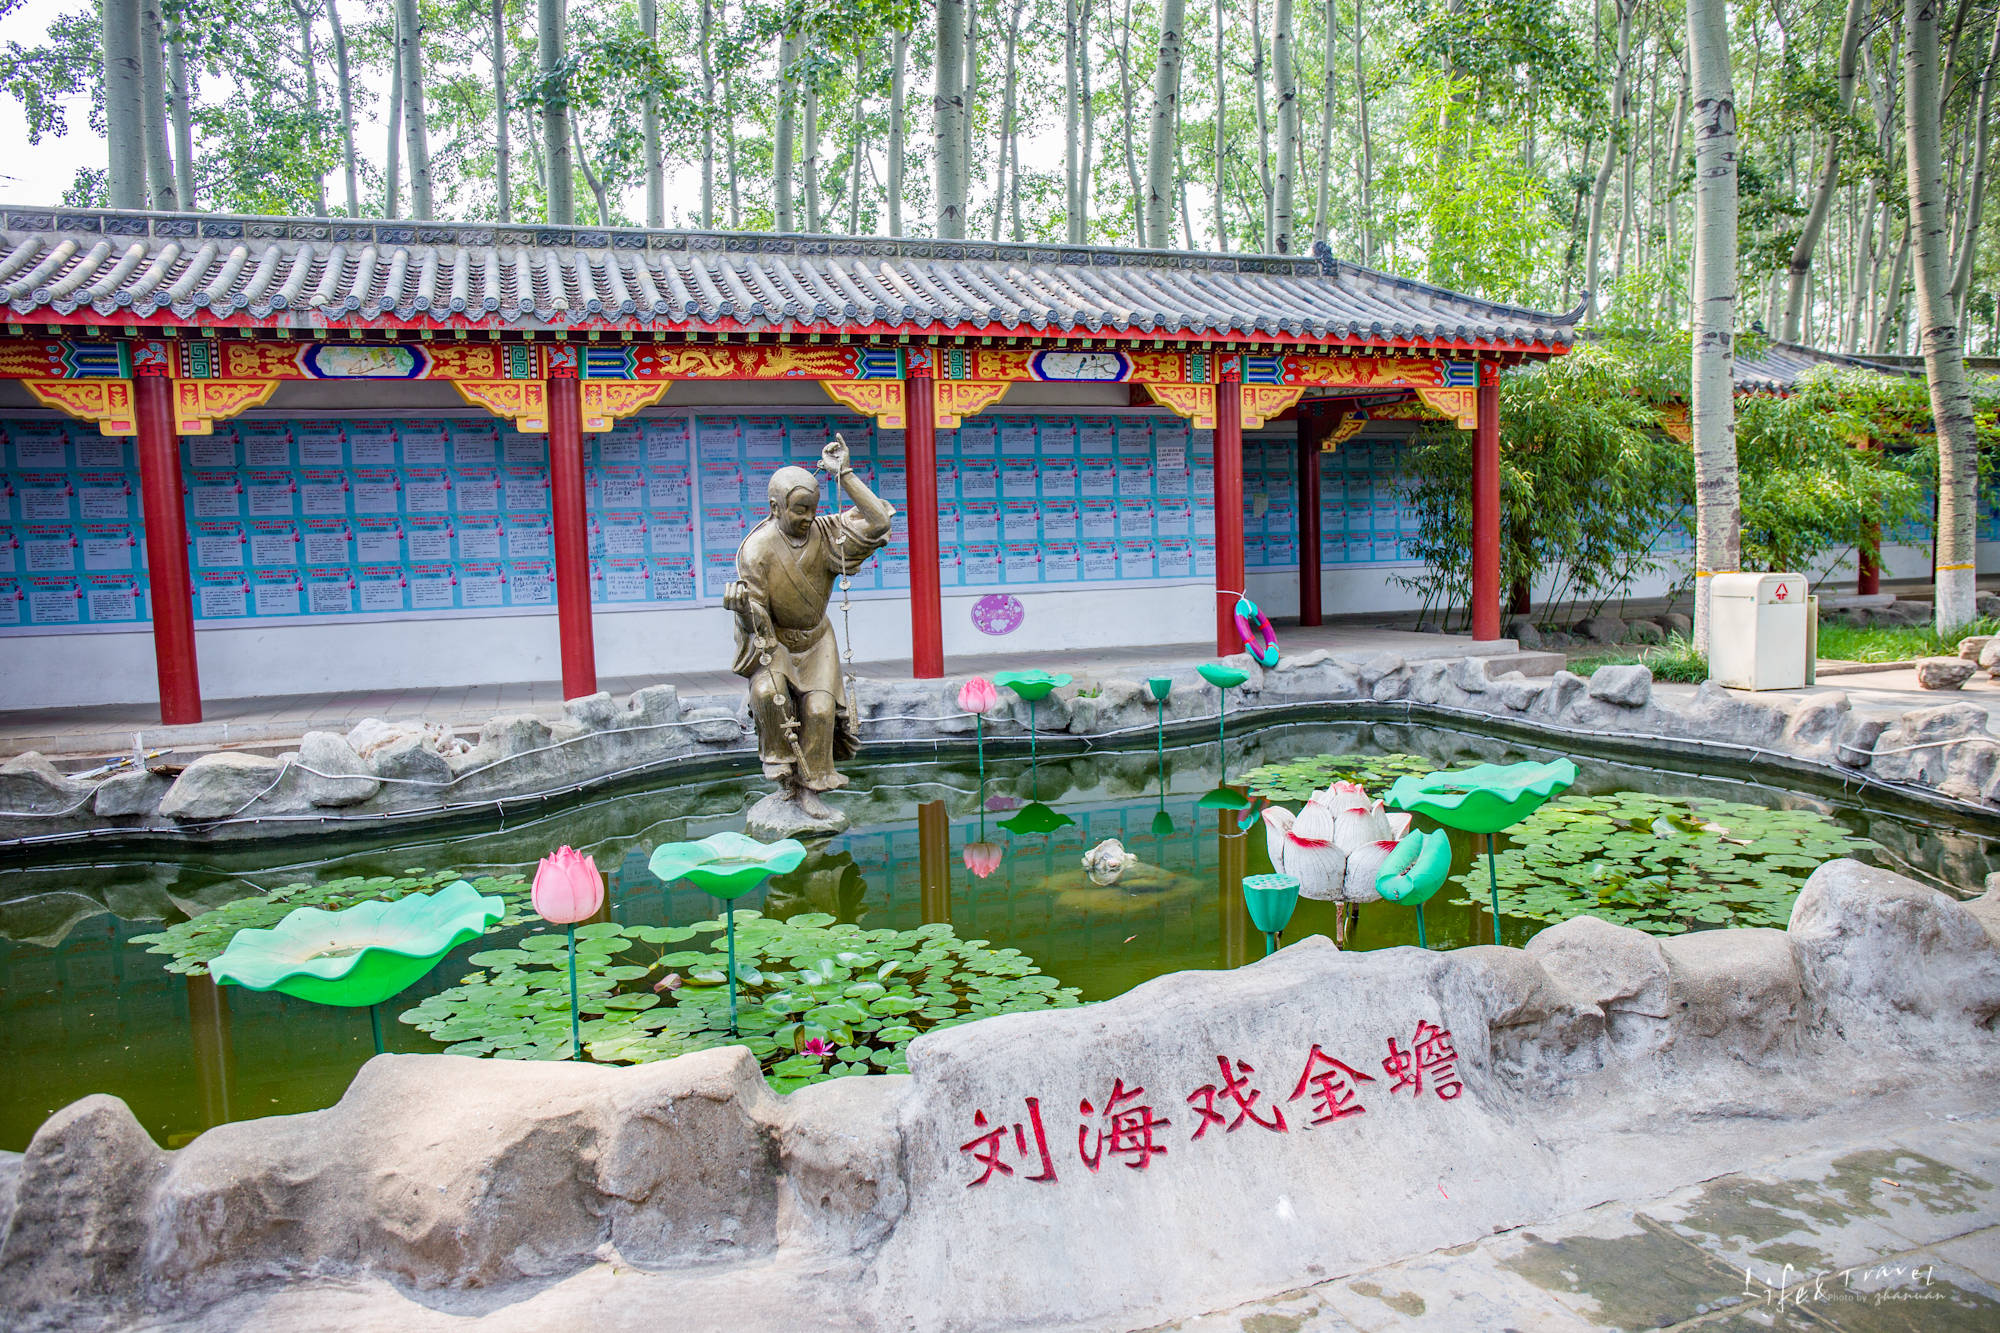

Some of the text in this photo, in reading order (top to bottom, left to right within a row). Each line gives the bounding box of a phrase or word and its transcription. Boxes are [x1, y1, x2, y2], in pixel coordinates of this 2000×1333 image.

[959, 1018, 1464, 1188] 刘海戏金蟾
